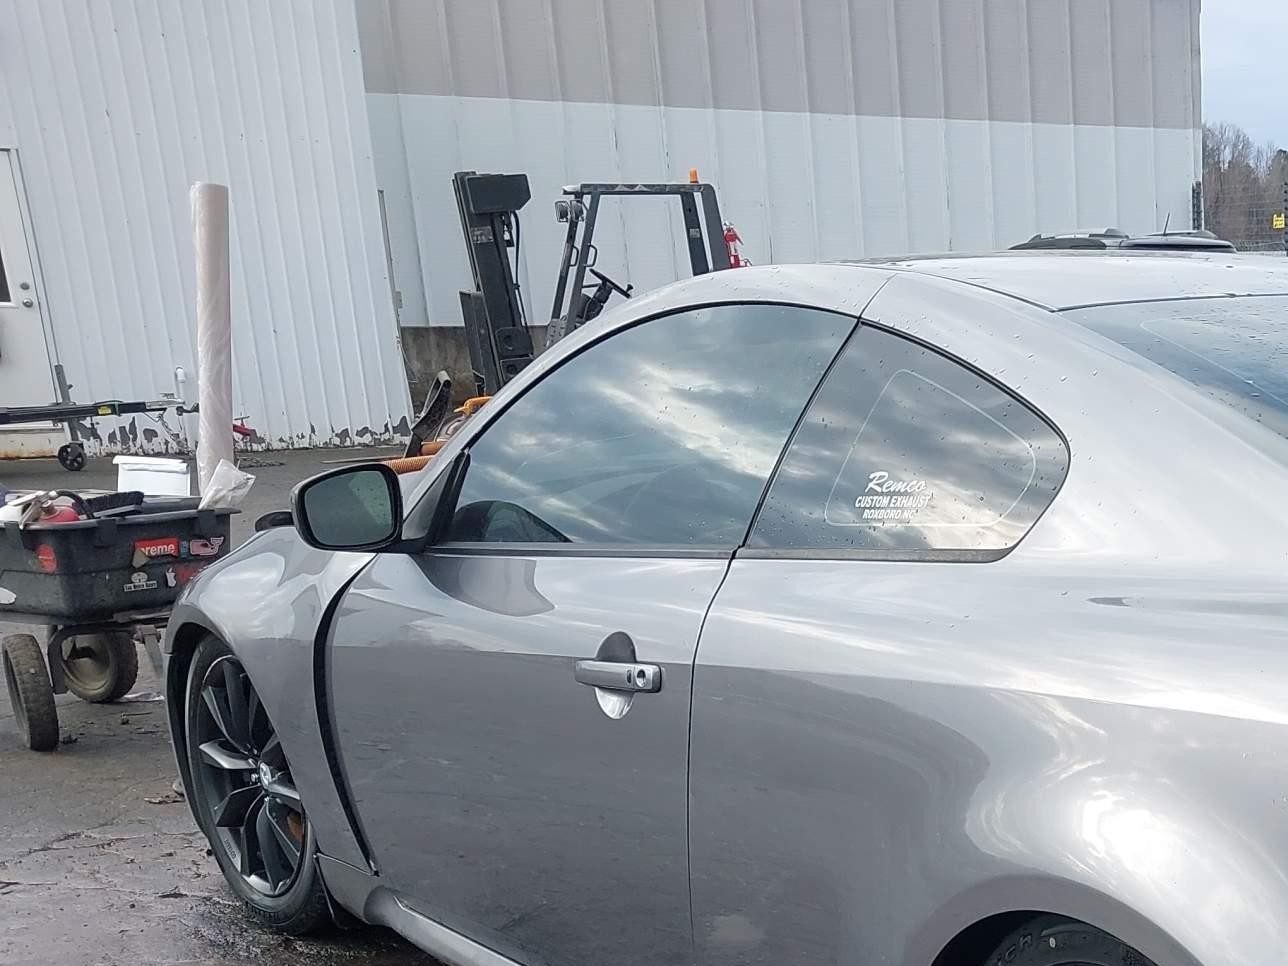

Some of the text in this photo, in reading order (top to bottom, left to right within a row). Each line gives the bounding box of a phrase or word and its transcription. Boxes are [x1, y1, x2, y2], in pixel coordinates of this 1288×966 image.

[865, 471, 926, 493] Remco
[855, 495, 930, 508] CUSTOM EXHAUST
[862, 509, 901, 519] ROXBORO
